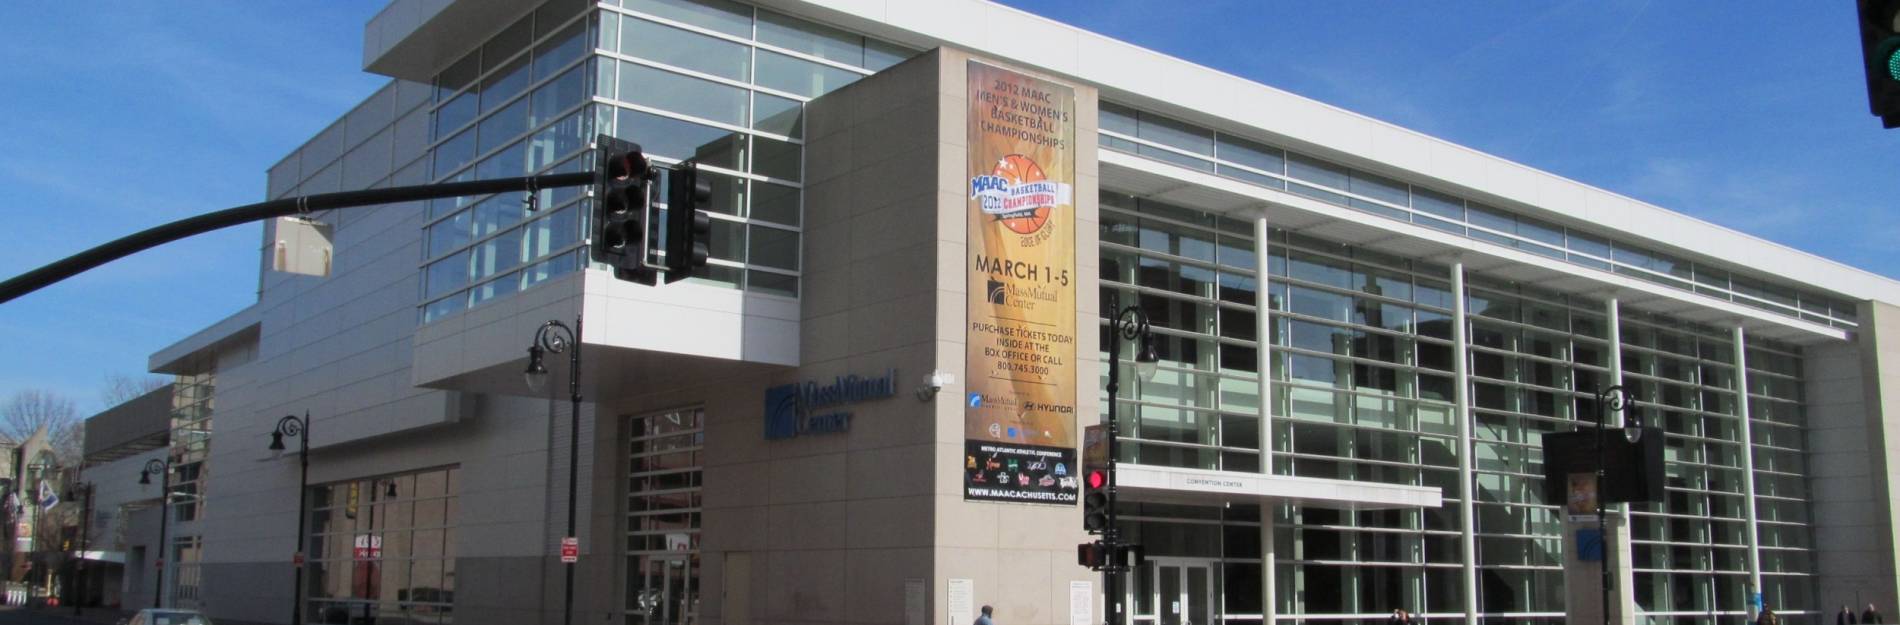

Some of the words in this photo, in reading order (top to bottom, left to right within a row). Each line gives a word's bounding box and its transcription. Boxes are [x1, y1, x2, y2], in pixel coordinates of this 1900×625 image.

[994, 80, 1019, 97] 2012
[1021, 87, 1052, 104] MAAC
[976, 90, 1009, 108] MEN'S
[1011, 99, 1018, 110] &
[1020, 101, 1068, 122] WOMEN'S
[992, 107, 1055, 134] BASKETBALL
[981, 120, 1065, 150] CHAMPIONSHIPS
[971, 175, 1009, 197] MAAC
[1011, 183, 1055, 196] BASKETBALL
[1003, 194, 1055, 210] CHAMPIONSHIPS
[976, 254, 1038, 281] MARCH
[1045, 266, 1069, 287] 1-5
[1006, 283, 1058, 303] MassMutual
[1006, 295, 1036, 310] Center
[973, 322, 1015, 337] PURCHASE
[1015, 327, 1047, 342] TICKETS
[1048, 333, 1073, 345] TODAY
[996, 337, 1023, 350] INSIDE
[1024, 342, 1034, 351] AT
[1035, 343, 1050, 353] THE
[985, 347, 1000, 358] BOX
[1002, 350, 1029, 362] OFFICE
[1030, 353, 1041, 363] OR
[1043, 355, 1063, 366] CALL
[1037, 404, 1074, 415] HYUNDAI
[1186, 478, 1222, 487] CONVENTION
[968, 487, 1077, 501] WWW.MAACACHUSETTS.COM
